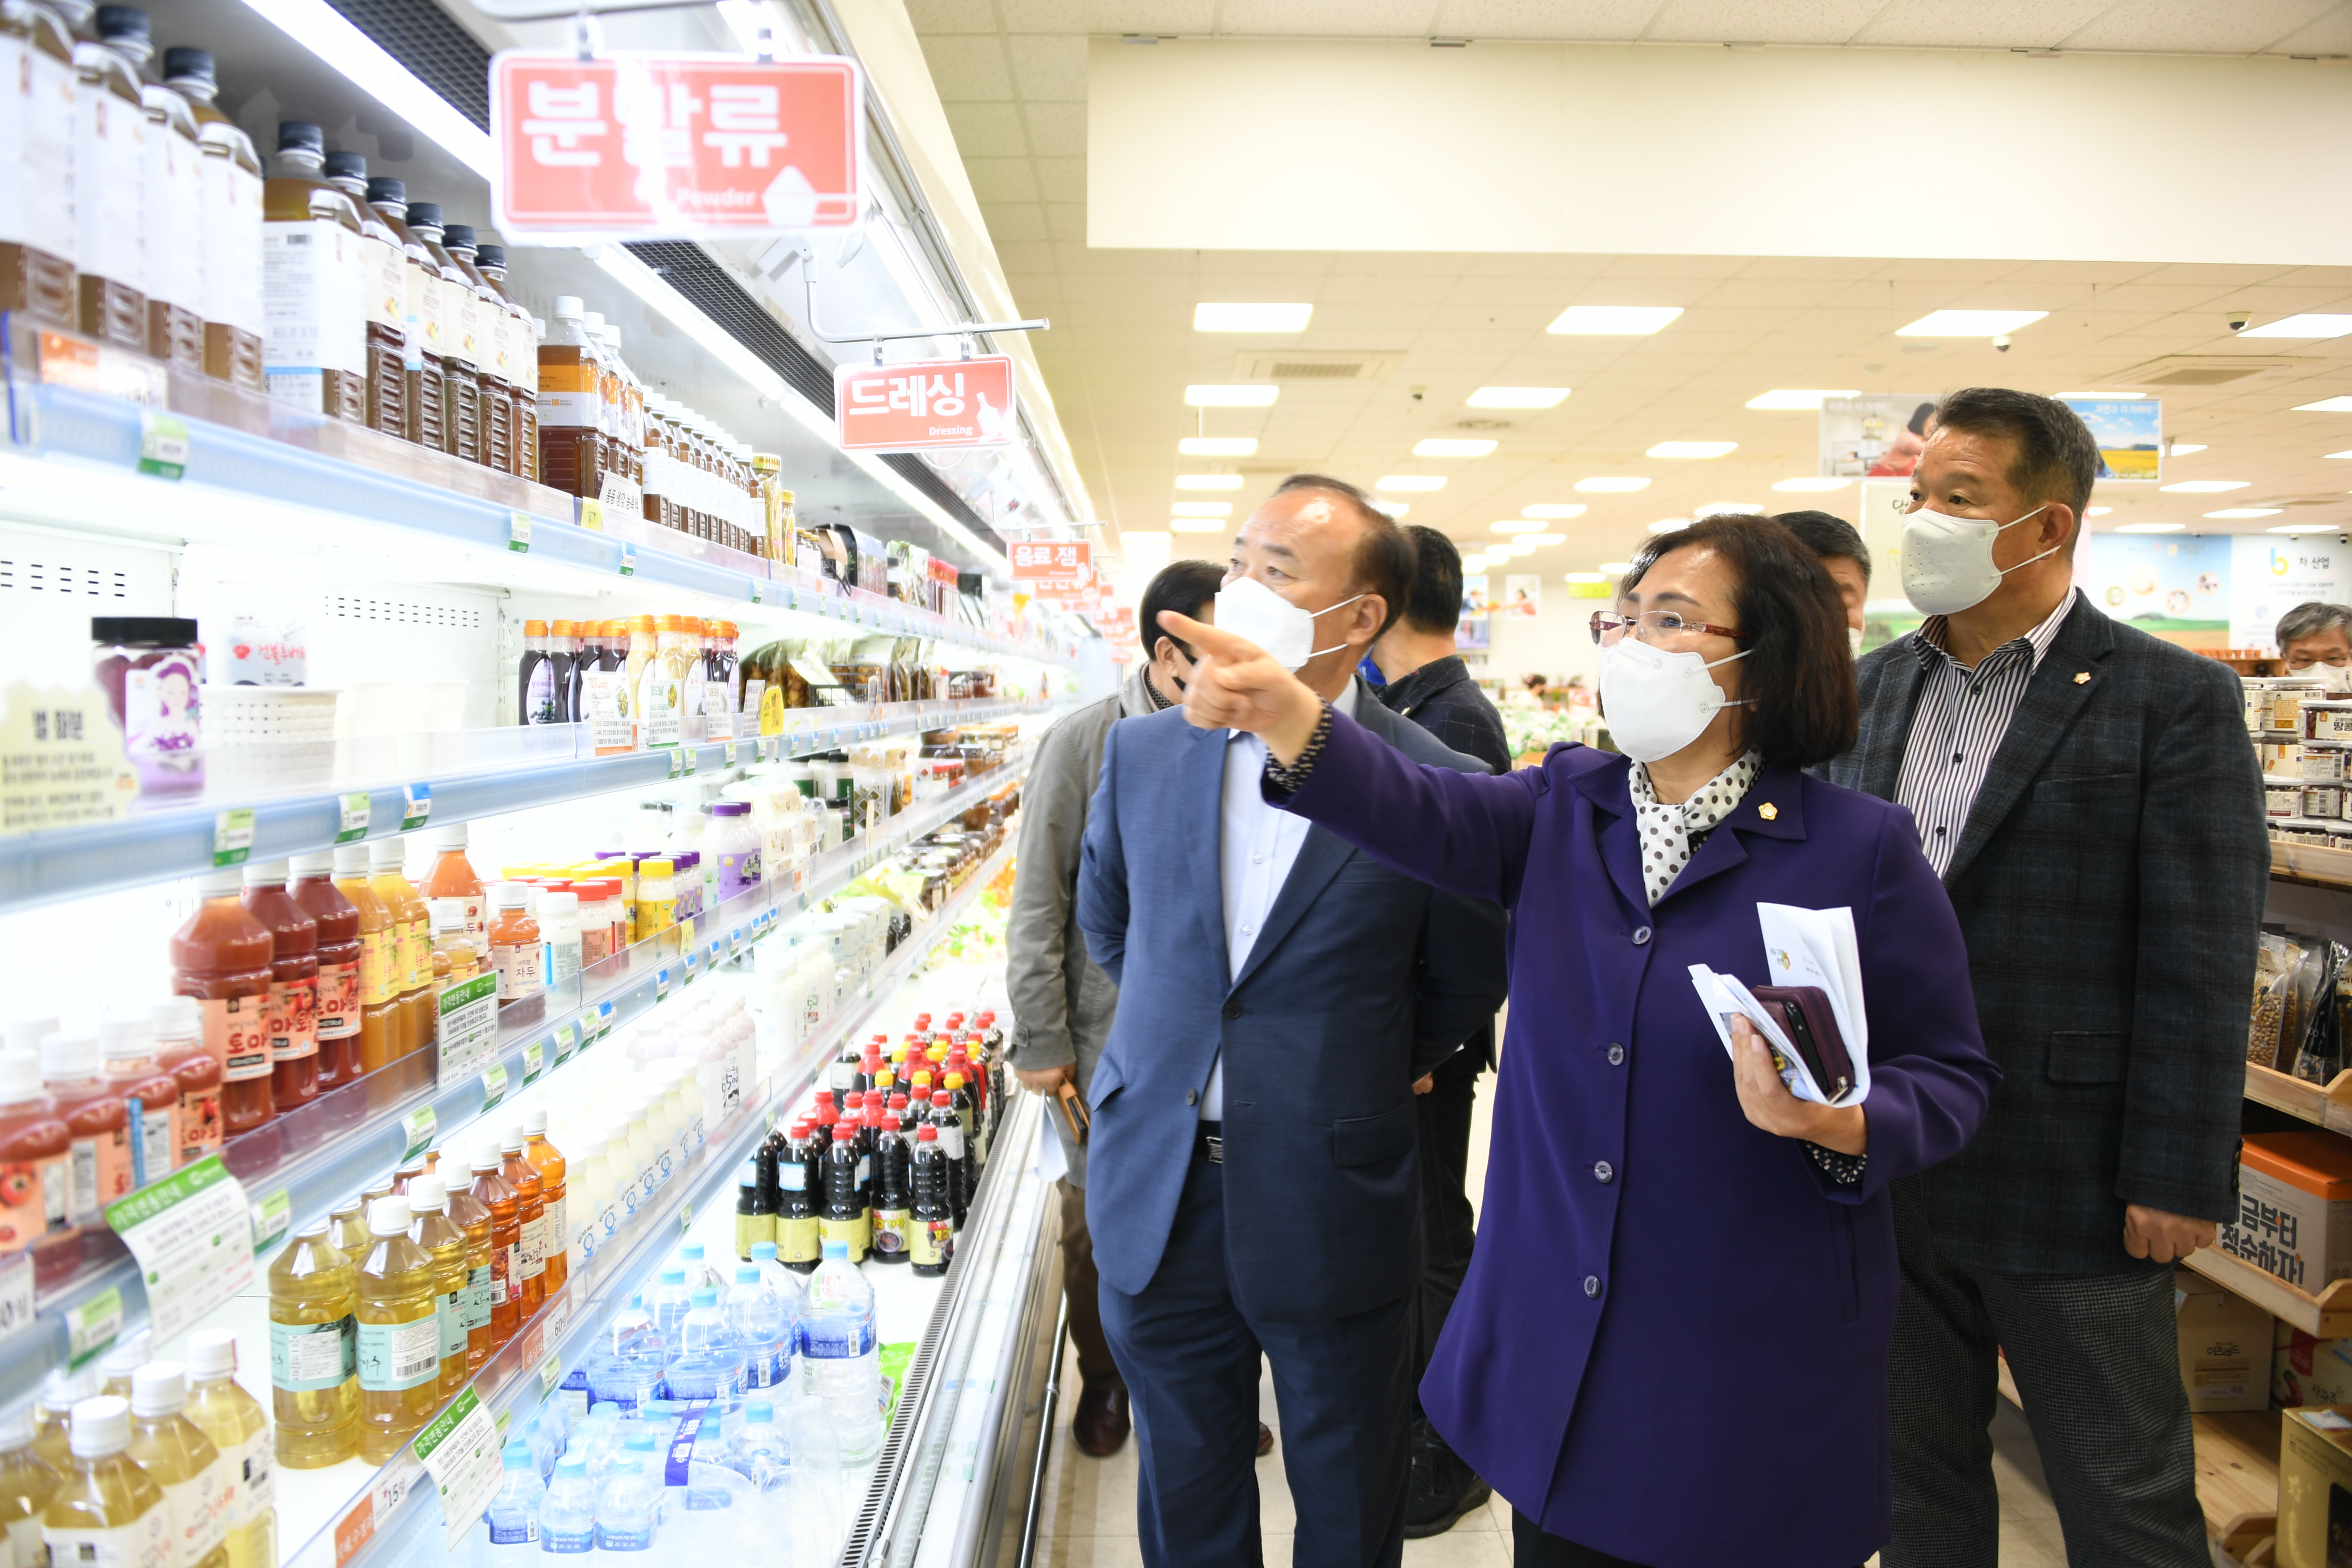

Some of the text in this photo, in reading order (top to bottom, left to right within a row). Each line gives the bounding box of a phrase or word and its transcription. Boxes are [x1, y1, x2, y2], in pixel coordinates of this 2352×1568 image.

[676, 187, 756, 207] Powder
[848, 373, 966, 417] 드레싱
[928, 425, 972, 437] Dressing
[604, 486, 614, 504] 봉동
[614, 490, 624, 508] 생강
[516, 966, 536, 977] 자두
[442, 986, 470, 1010] 가격변동안내
[2240, 1193, 2297, 1250] 금부터
[555, 1314, 566, 1337] 60일
[416, 1412, 455, 1454] 가격변동안내
[388, 1477, 405, 1508] 15일
